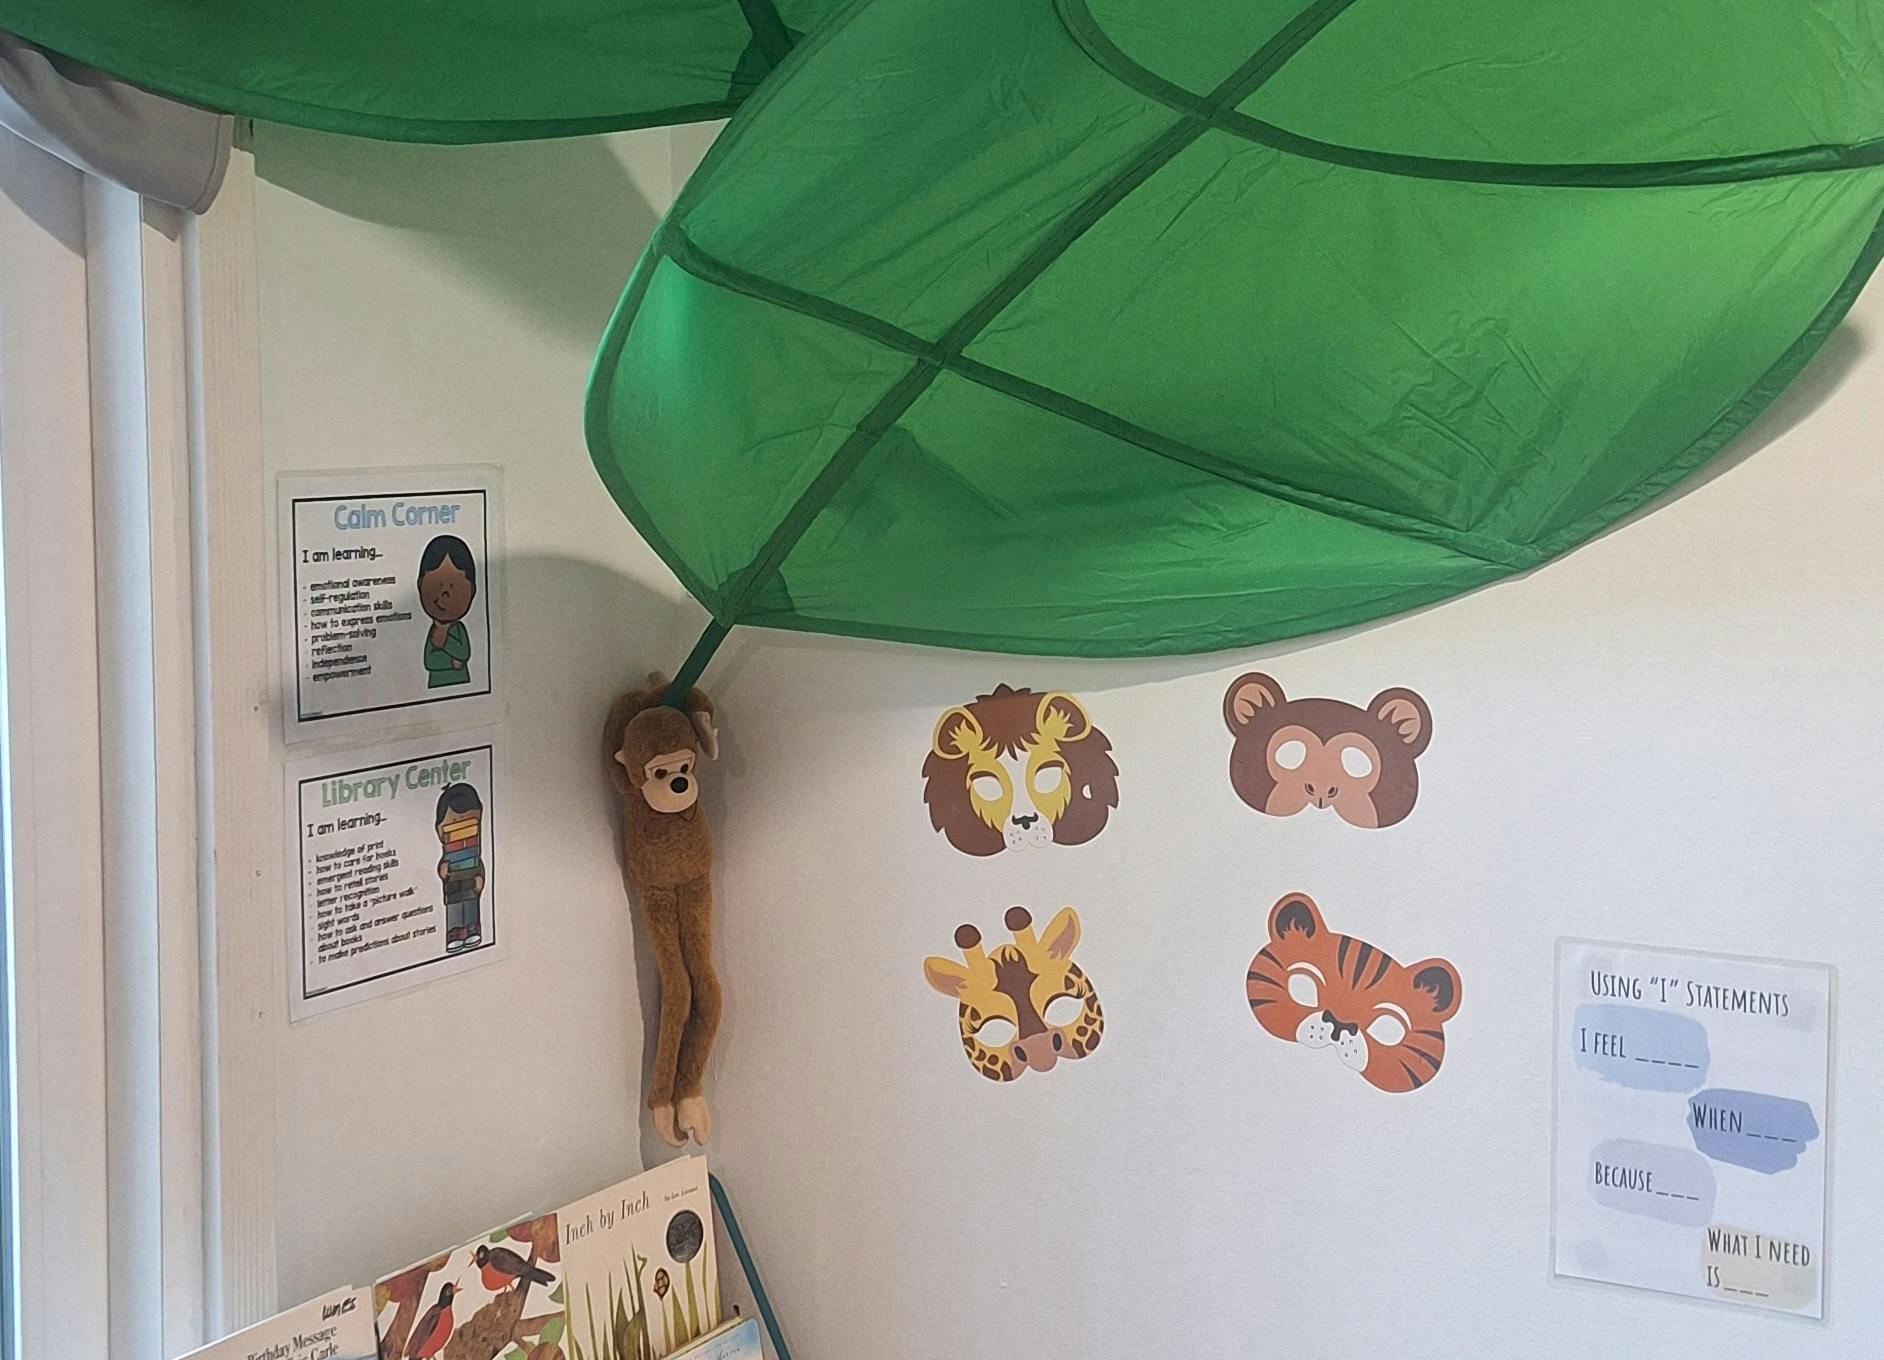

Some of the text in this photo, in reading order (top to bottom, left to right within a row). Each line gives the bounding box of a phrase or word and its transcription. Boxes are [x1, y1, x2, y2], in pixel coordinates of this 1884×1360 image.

[334, 502, 461, 531] Calm Corner
[301, 549, 310, 564] I
[311, 551, 330, 563] am
[310, 591, 370, 605] self-regulation
[310, 600, 393, 618] communication skills
[310, 621, 328, 631] how
[330, 618, 339, 629] to
[341, 616, 374, 629] express
[311, 628, 377, 646] problem-solving
[311, 643, 353, 657] reflection
[321, 759, 472, 808] Library Center
[306, 823, 314, 838] I
[317, 822, 335, 836] am
[315, 839, 384, 863] knowledge of print
[316, 865, 332, 875] how
[333, 861, 342, 871] to
[343, 857, 361, 868] care
[362, 853, 374, 862] for
[354, 863, 382, 876] reading
[383, 858, 400, 870] skills
[316, 886, 332, 897] how
[334, 883, 342, 893] to
[344, 877, 363, 891] retell
[316, 886, 381, 908] letter recognition
[316, 909, 333, 920] how
[334, 904, 343, 915] to
[344, 901, 362, 913] take
[317, 912, 360, 931] sight words
[317, 904, 434, 942] how to ask and answer questions
[318, 934, 363, 953] about books
[318, 925, 437, 964] to make predictions about stories
[1590, 969, 1791, 1018] USING "I" STATEMENTS
[1579, 1026, 1627, 1059] I FEEL
[1692, 1101, 1743, 1135] WHEN
[1594, 1160, 1654, 1194] BECAUSE
[565, 1190, 651, 1246] Inch by Inch
[1707, 1226, 1811, 1267] WHAT I NEED
[1706, 1264, 1722, 1288] IS
[291, 1324, 338, 1353] Message
